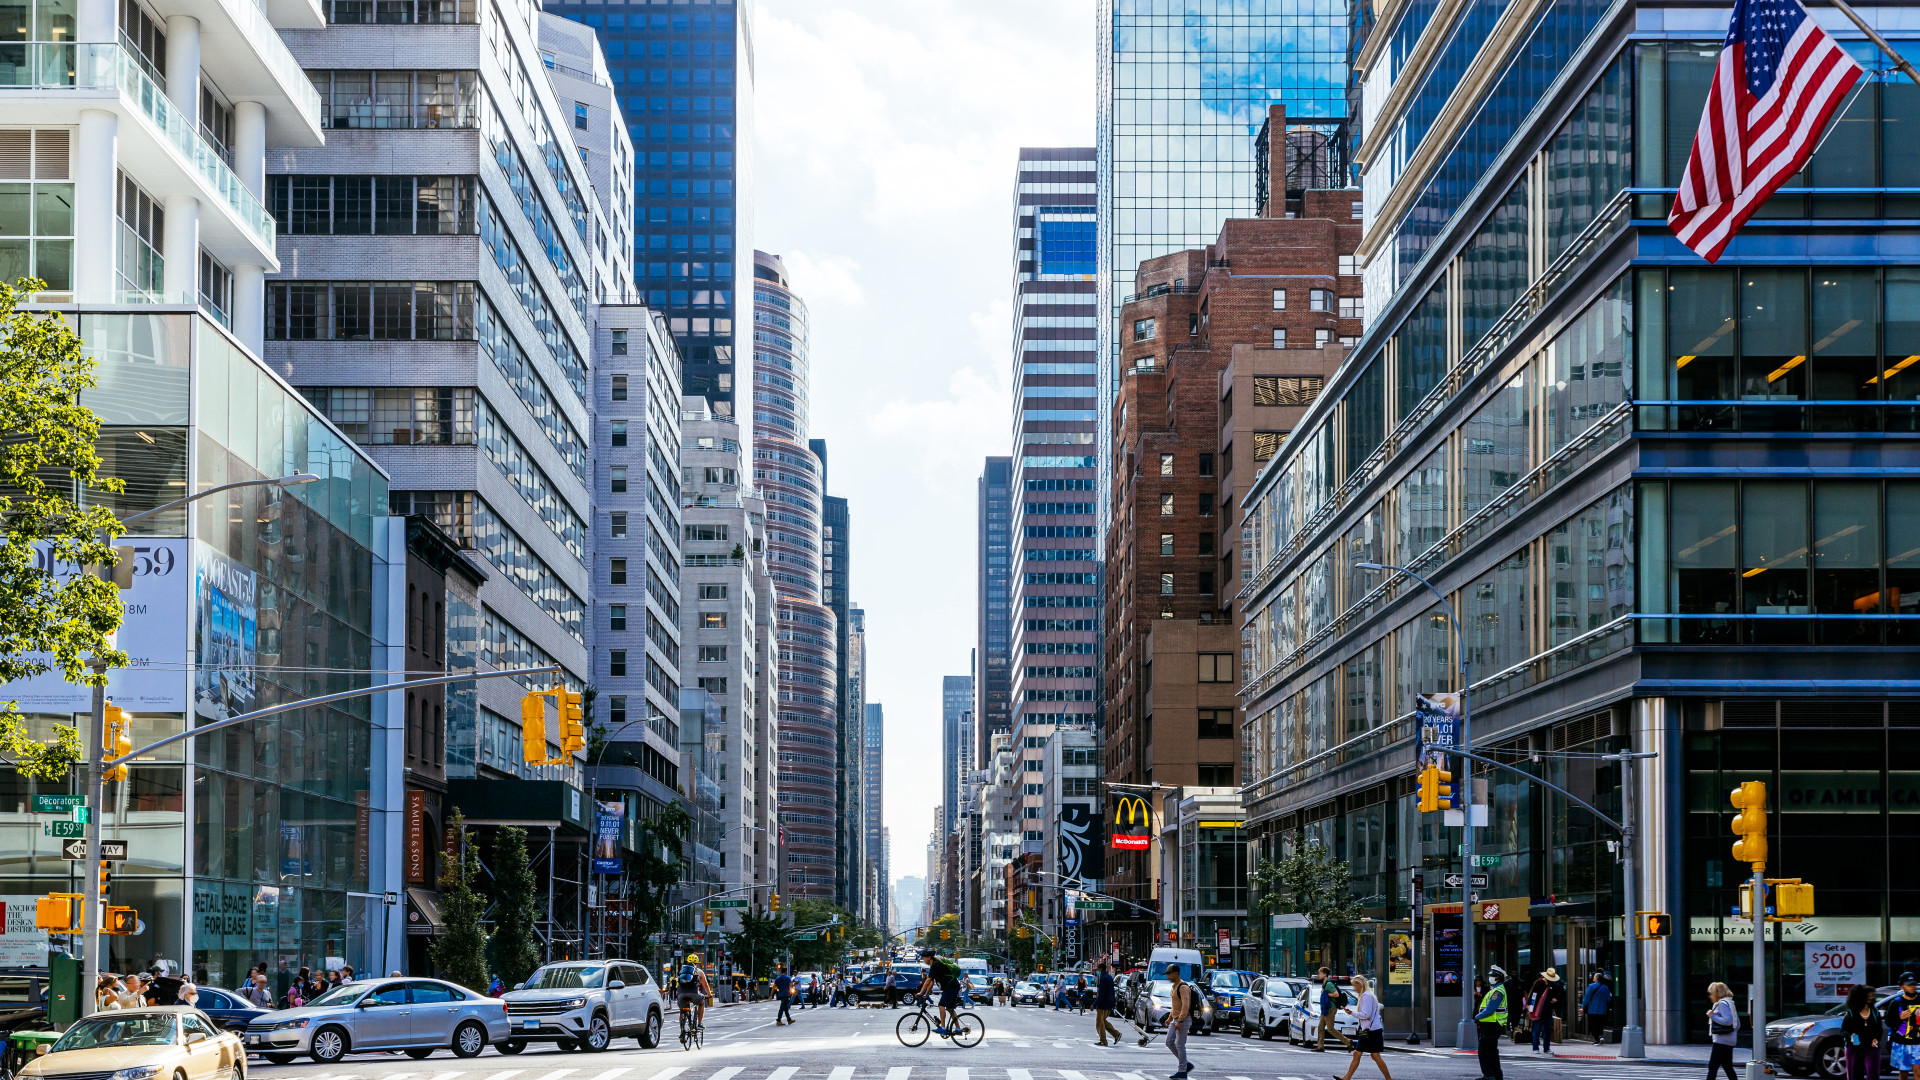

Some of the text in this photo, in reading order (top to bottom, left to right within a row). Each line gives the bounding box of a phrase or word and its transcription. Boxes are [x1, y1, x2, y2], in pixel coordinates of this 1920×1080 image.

[39, 796, 80, 805] Decorators
[411, 796, 420, 839] SAMUEL
[600, 820, 620, 828] 9.11.01
[55, 823, 82, 835] E 59 St
[600, 827, 620, 835] NEVER
[1115, 838, 1148, 846] McDonald's
[100, 845, 120, 854] WAY
[411, 848, 420, 877] SONS
[1481, 856, 1486, 866] E
[1486, 856, 1495, 866] 59
[194, 892, 247, 914] RETAIL SPACE
[7, 904, 38, 912] ANCHOR
[7, 911, 23, 919] THE
[7, 925, 39, 933] DISTRICT
[204, 915, 247, 935] FOR LEASE
[1690, 927, 1720, 935] BANK
[1723, 927, 1737, 935] OF
[1824, 944, 1839, 952] Get
[1812, 952, 1856, 970] $200
